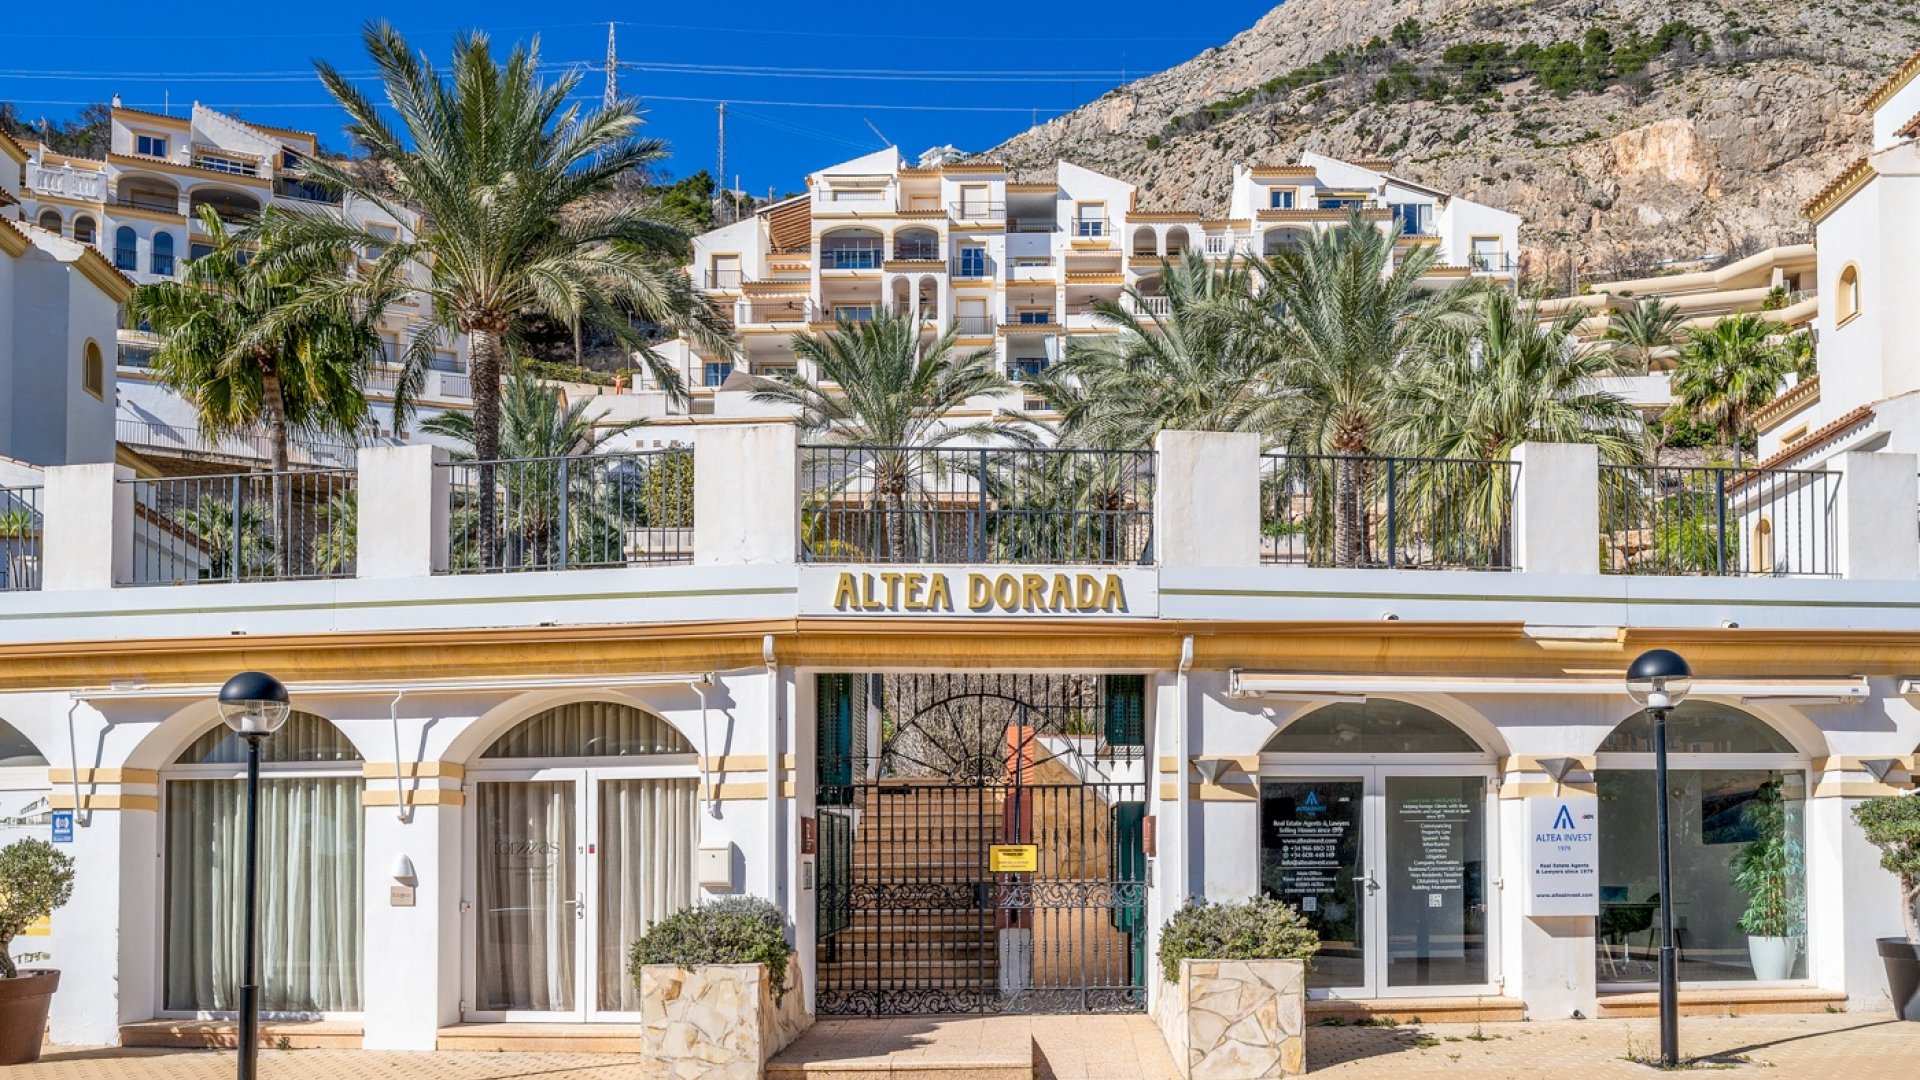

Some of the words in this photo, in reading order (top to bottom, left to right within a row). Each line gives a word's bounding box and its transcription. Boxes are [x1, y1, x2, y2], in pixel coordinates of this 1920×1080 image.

[834, 572, 950, 609] ALTEA
[968, 572, 1125, 610] DORADA
[1303, 820, 1322, 828] Agents
[1322, 820, 1329, 828] &
[1329, 820, 1350, 829] Lawyers
[1536, 833, 1562, 842] ALTEA
[1564, 833, 1592, 842] INVEST
[494, 839, 560, 856] formas
